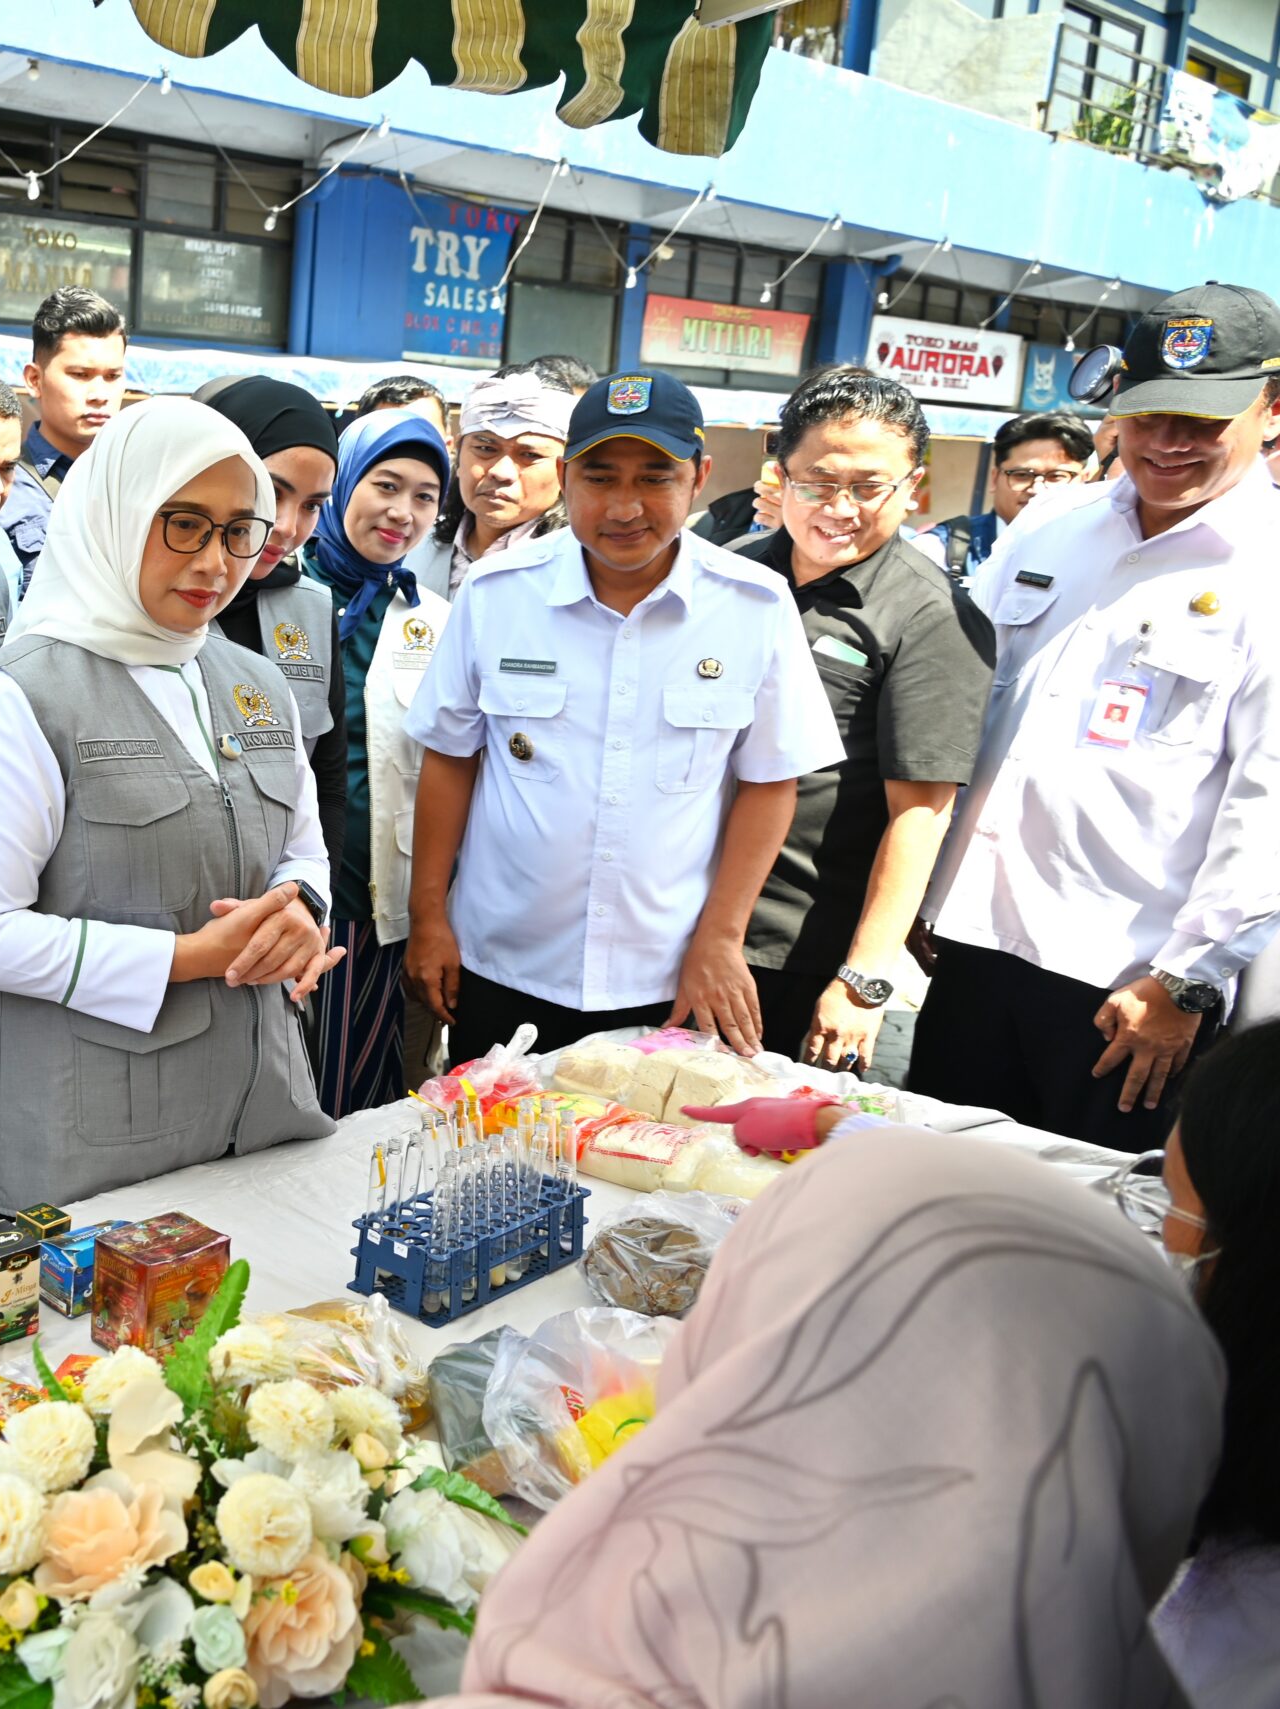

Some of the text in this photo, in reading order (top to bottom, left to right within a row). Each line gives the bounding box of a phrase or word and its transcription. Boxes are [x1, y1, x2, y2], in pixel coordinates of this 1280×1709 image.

[24, 226, 77, 252] TOKO
[410, 226, 491, 280] TRY
[424, 282, 487, 313] SALES
[679, 317, 773, 360] MUTIARA
[905, 334, 978, 352] TOKO MAS
[890, 346, 989, 377] AURORA
[281, 665, 312, 677] OMISI
[82, 742, 126, 758] NIHAYATUL
[242, 733, 293, 747] KOMISI IX
